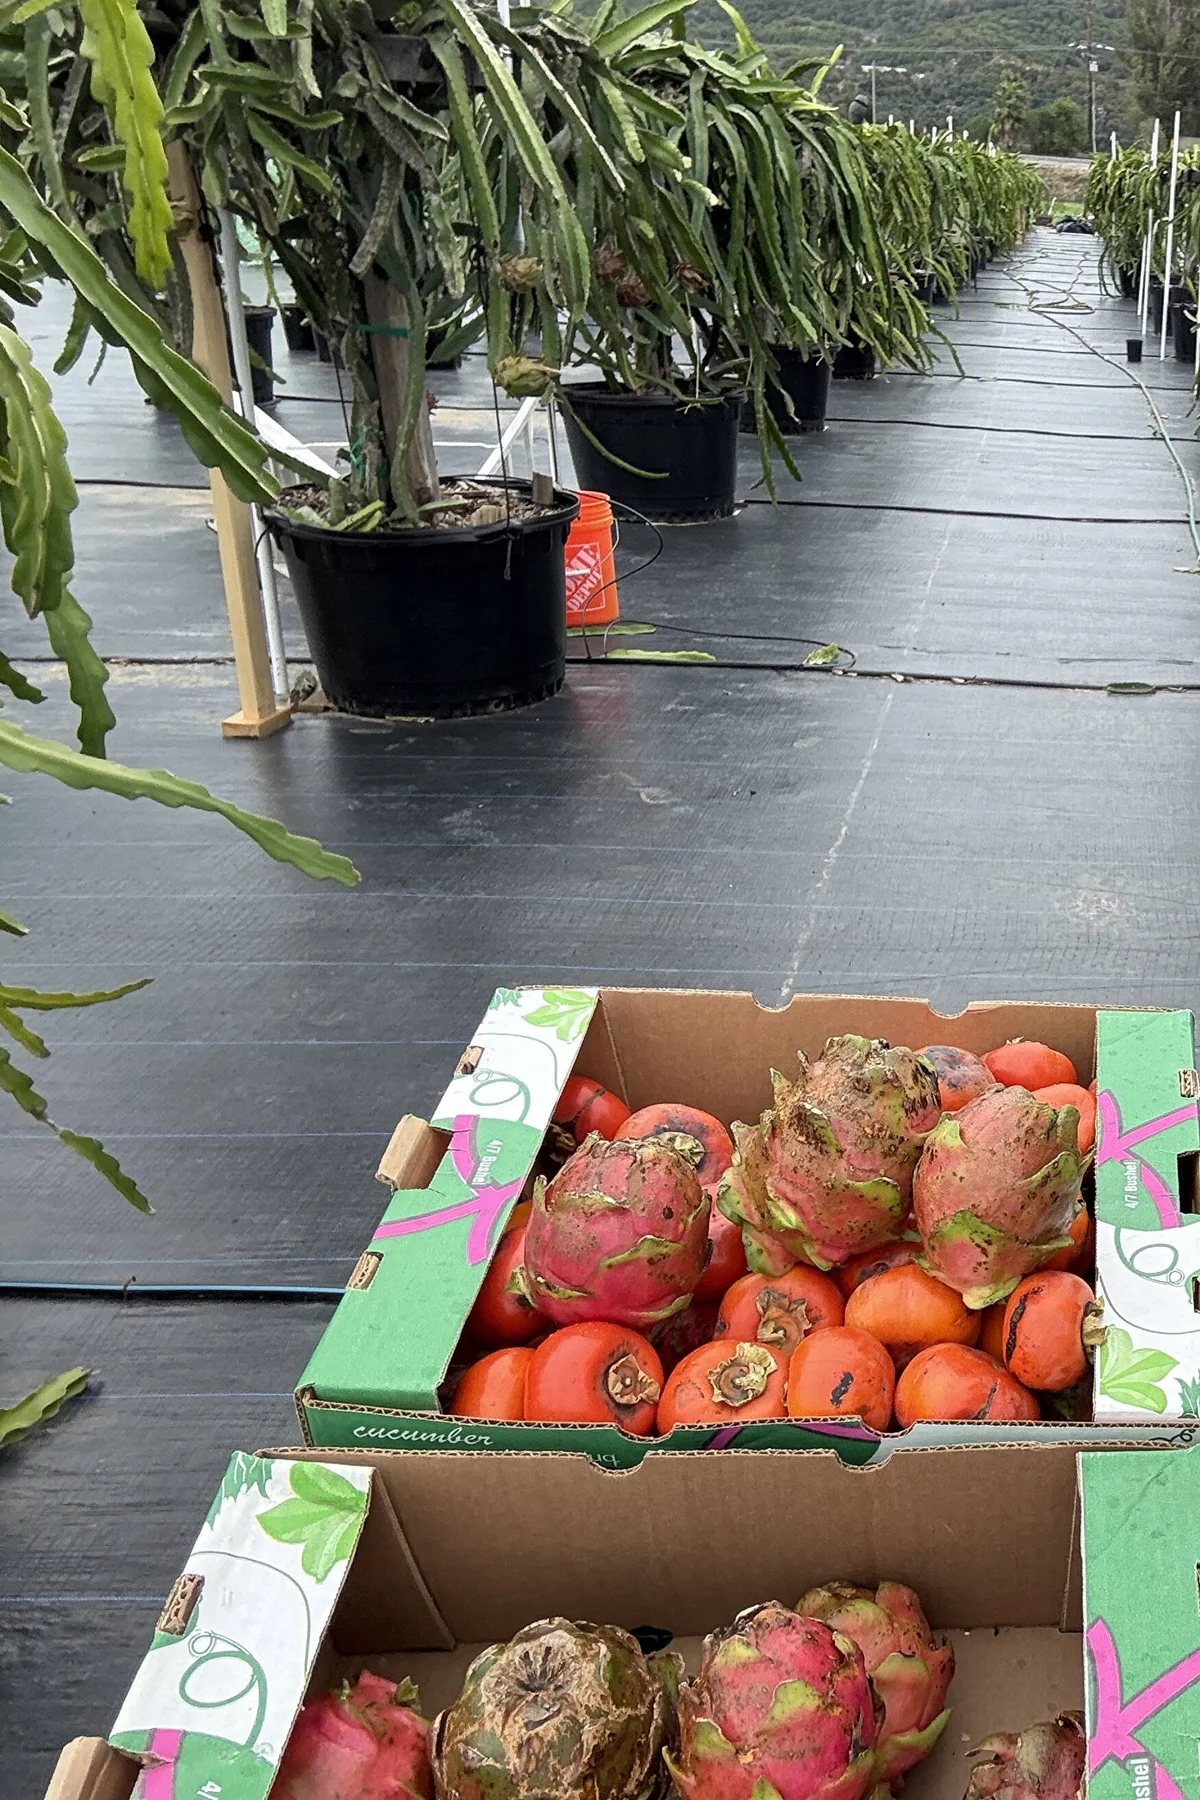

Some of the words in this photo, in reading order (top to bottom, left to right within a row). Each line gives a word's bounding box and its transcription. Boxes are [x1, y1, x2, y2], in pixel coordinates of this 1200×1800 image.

[565, 544, 599, 597] OME
[566, 564, 602, 612] DEPOT
[486, 1139, 504, 1154] 4/7
[471, 1155, 499, 1185] Bushel
[1122, 1160, 1138, 1192] Bushel
[1124, 1193, 1139, 1209] 4/7
[352, 1426, 494, 1446] cucumber
[196, 1780, 222, 1800] 4/
[1130, 1757, 1151, 1800] shel
